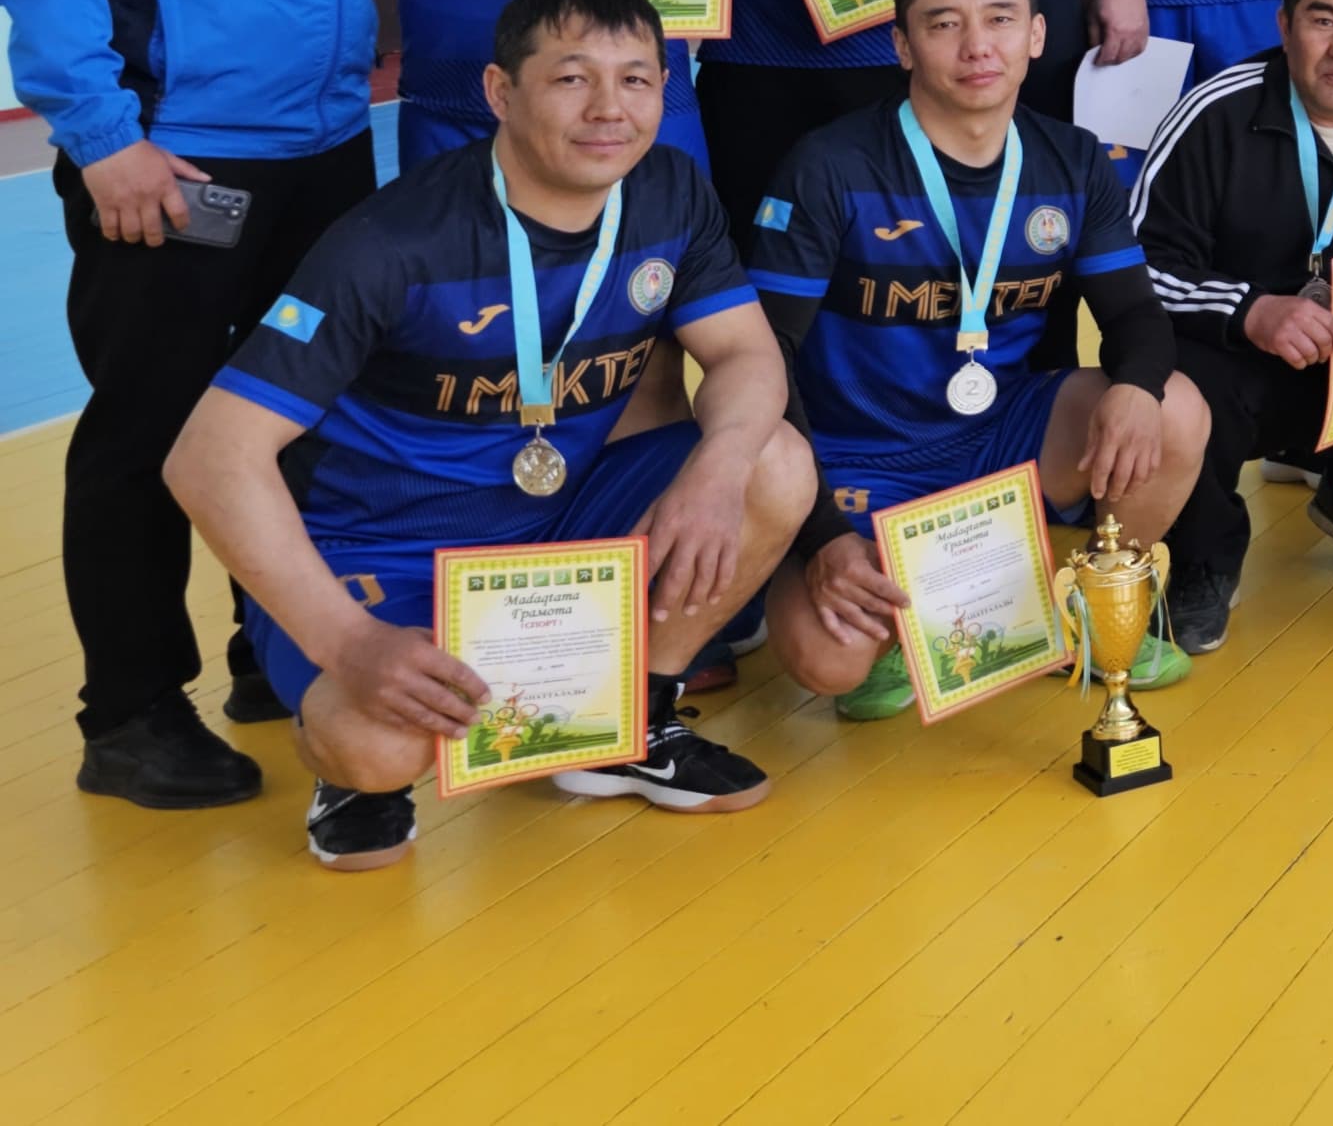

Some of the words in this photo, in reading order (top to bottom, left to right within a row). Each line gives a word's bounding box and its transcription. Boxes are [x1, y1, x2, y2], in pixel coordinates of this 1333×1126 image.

[858, 277, 876, 316] 1
[885, 271, 1063, 321] METEP
[435, 374, 457, 412] 1
[466, 337, 656, 414] MKTE
[965, 379, 979, 396] 2
[511, 606, 573, 622] Грамота
